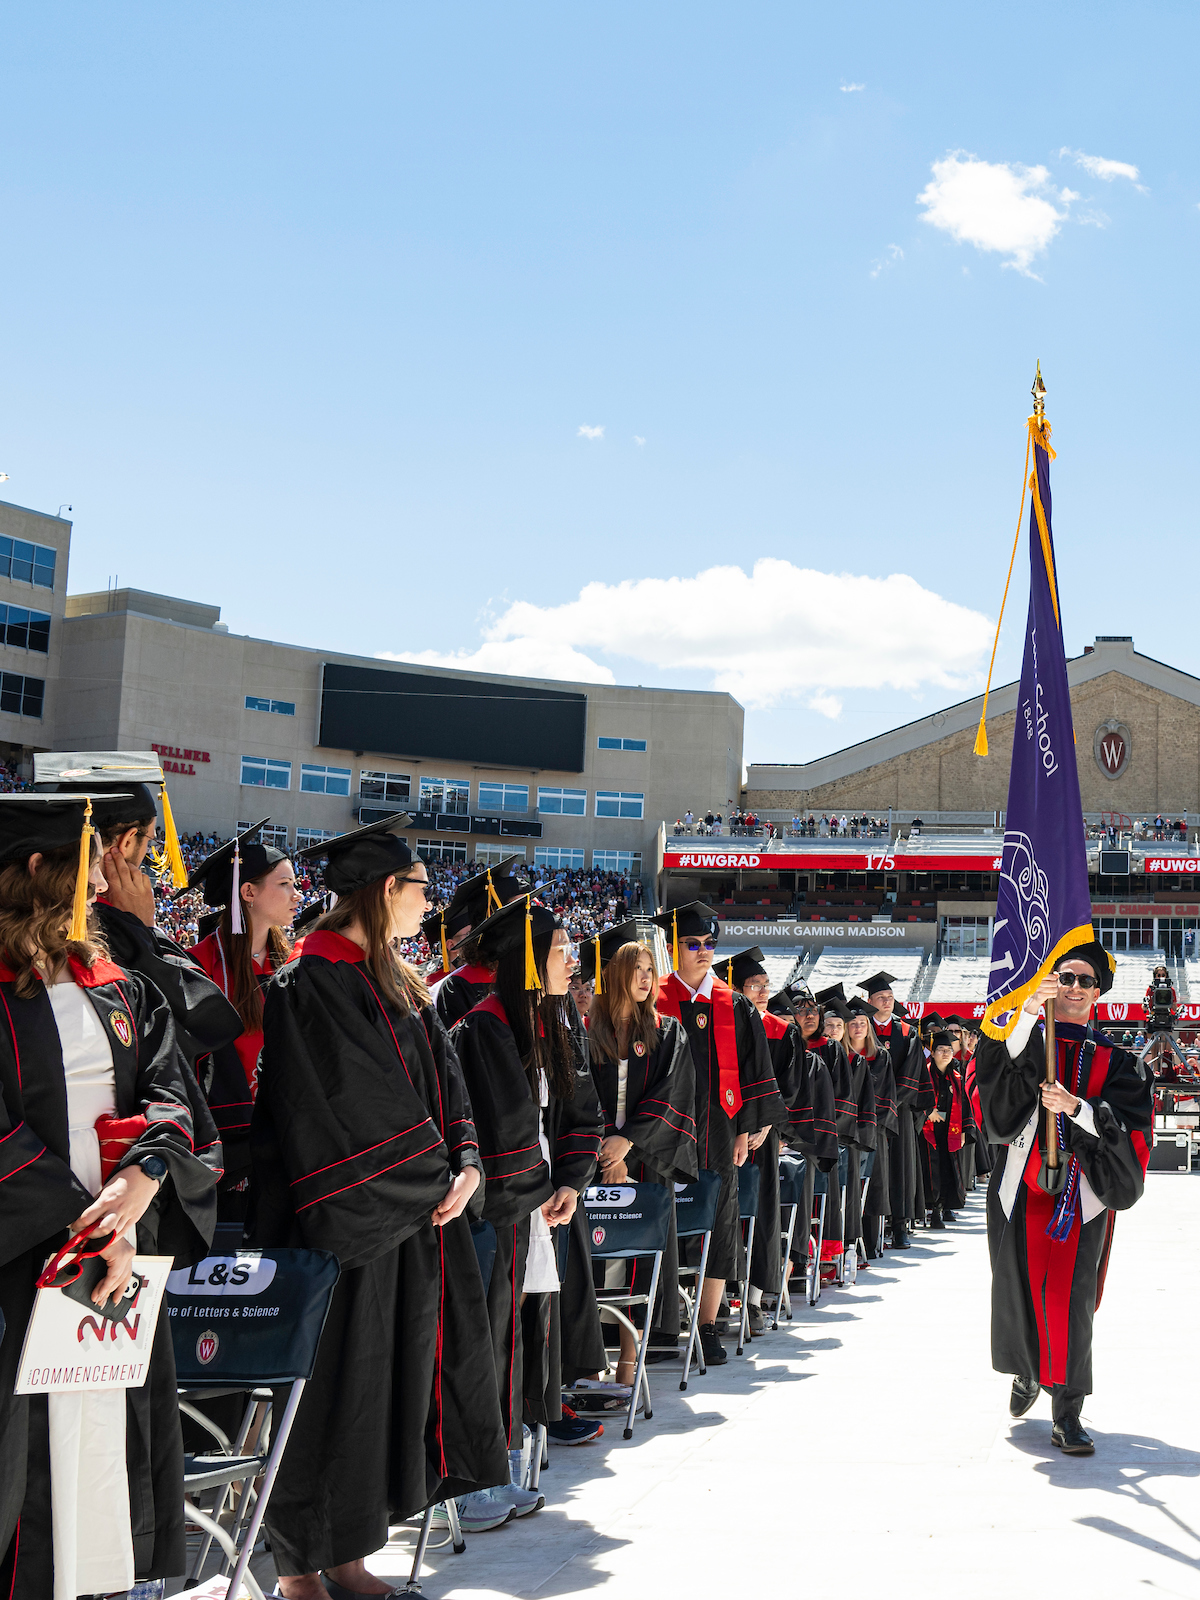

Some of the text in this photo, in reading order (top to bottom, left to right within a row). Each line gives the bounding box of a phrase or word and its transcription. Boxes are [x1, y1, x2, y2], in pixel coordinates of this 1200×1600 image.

[1022, 698, 1034, 740] 1848
[151, 743, 211, 763] KELLNER
[1102, 740, 1123, 768] W
[163, 760, 196, 776] HALL
[679, 854, 761, 867] #UWGRAD
[864, 853, 896, 871] 175
[1092, 904, 1199, 916] MING CHAMPIONS CLUB
[725, 925, 906, 937] HO-CHUNK GAMING MADISON
[115, 1022, 129, 1041] W
[583, 1189, 621, 1202] L&S
[589, 1212, 642, 1220] Letters & Science
[187, 1263, 252, 1286] L&S
[180, 1305, 193, 1317] of
[193, 1306, 230, 1318] Letters
[232, 1307, 240, 1317] &
[242, 1305, 280, 1317] Science
[77, 1315, 108, 1343] 2
[31, 1363, 144, 1386] COMMENCEMENT
